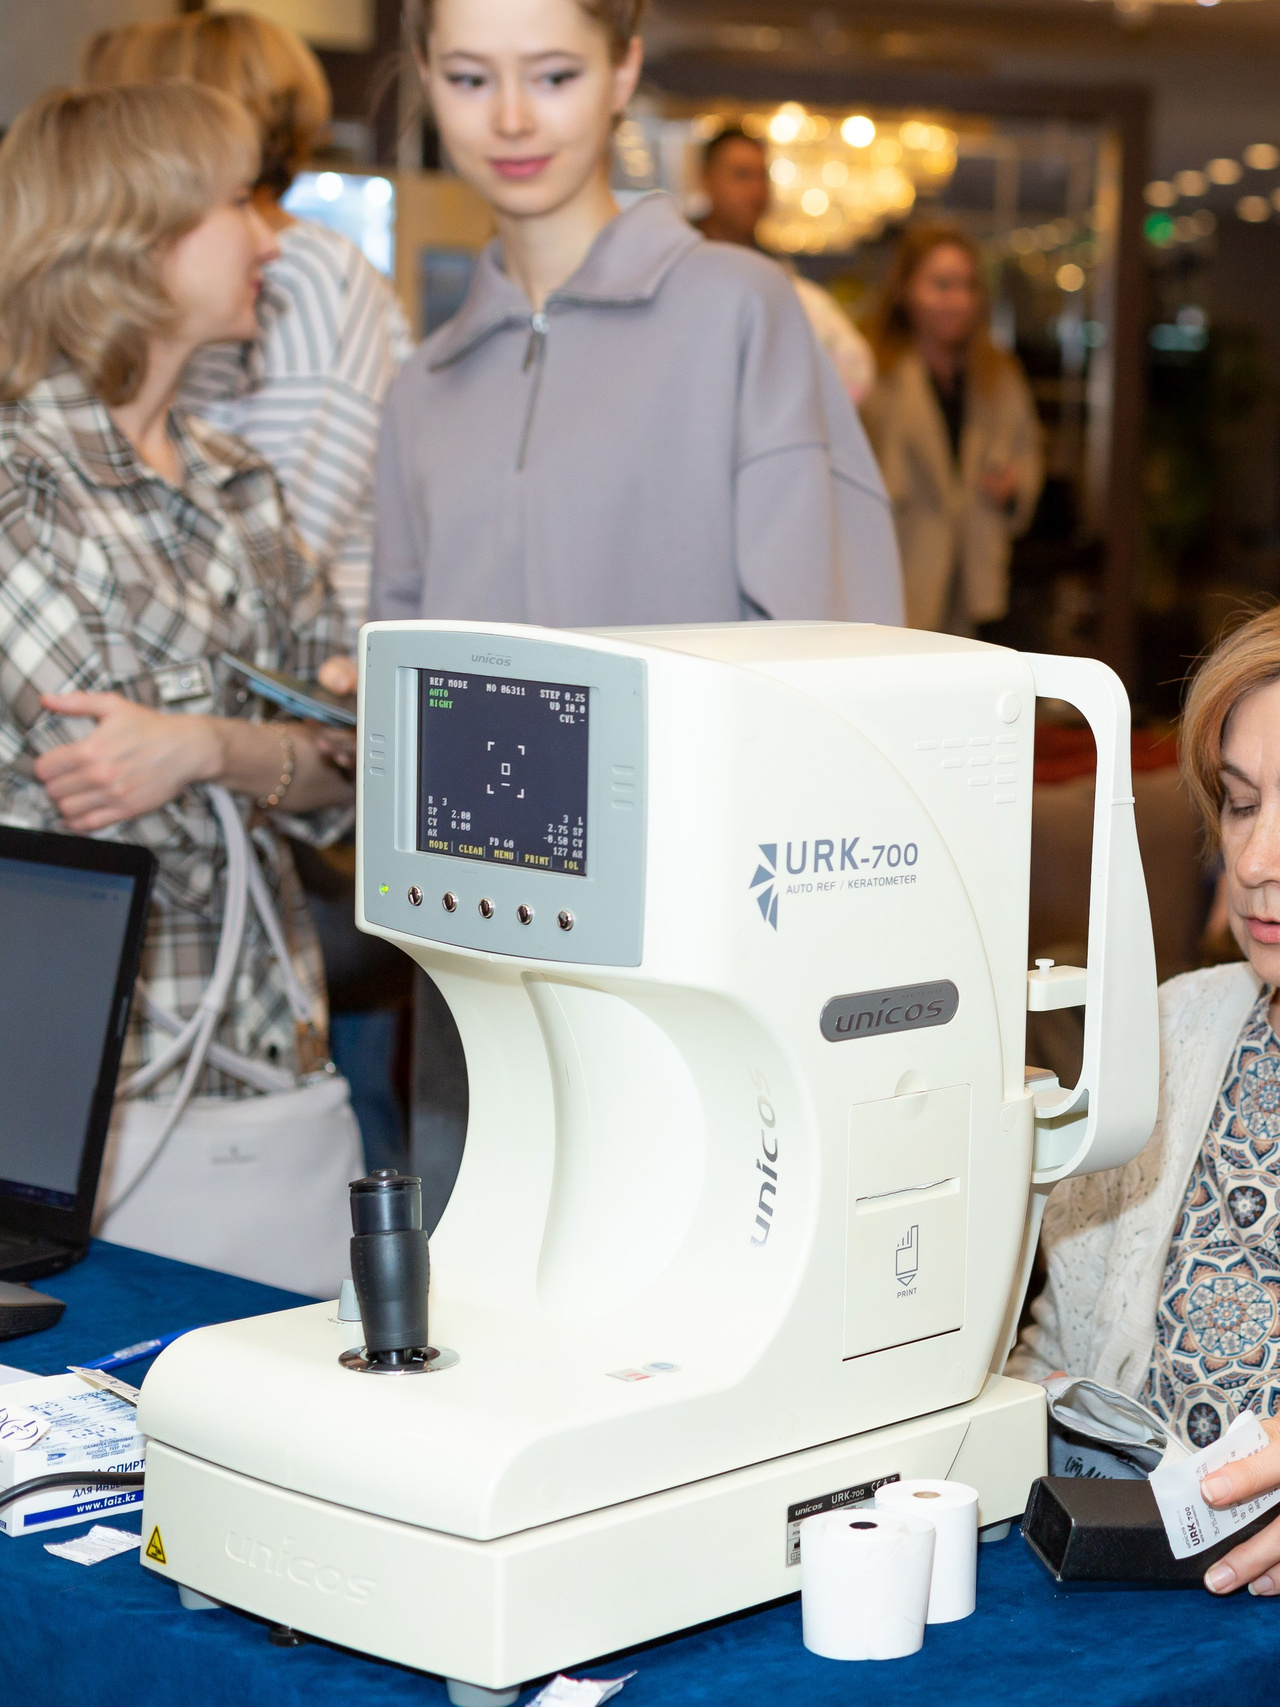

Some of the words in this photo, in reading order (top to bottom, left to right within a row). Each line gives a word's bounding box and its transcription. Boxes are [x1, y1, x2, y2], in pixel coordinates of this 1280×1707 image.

[471, 652, 511, 667] unicos
[429, 677, 444, 687] REF
[447, 679, 468, 689] MODE
[486, 683, 497, 692] NO
[500, 685, 526, 696] 06311
[429, 688, 449, 698] AUTO
[540, 689, 560, 700] STEP
[564, 692, 586, 703] 0.25
[429, 698, 453, 709] RIGHT
[442, 797, 448, 807] 3
[427, 806, 438, 816] SP
[451, 809, 471, 820] 2.00
[563, 814, 569, 824] 3
[577, 816, 583, 826] L
[547, 823, 569, 835] 2.75
[572, 826, 583, 836] SP
[489, 837, 500, 847] PD
[503, 839, 514, 849] 60
[542, 835, 568, 846] -0.50
[428, 839, 449, 850] MODE
[458, 844, 483, 856] CLEAR
[494, 849, 514, 860] MENU
[525, 854, 549, 866] PRINT
[563, 860, 579, 870] IOL
[553, 846, 568, 857] 127
[786, 837, 918, 875] URK-700
[786, 883, 813, 895] AUTO
[816, 881, 836, 892] REF
[847, 874, 917, 890] KERATOMETER
[835, 997, 945, 1033] unicos
[897, 1287, 917, 1299] PRINT
[72, 1485, 93, 1499] ДЛЯ
[76, 1493, 136, 1513] www.faiz.kz
[795, 1502, 823, 1517] unicos
[831, 1488, 865, 1504] URK-700
[224, 1530, 377, 1605] unicos
